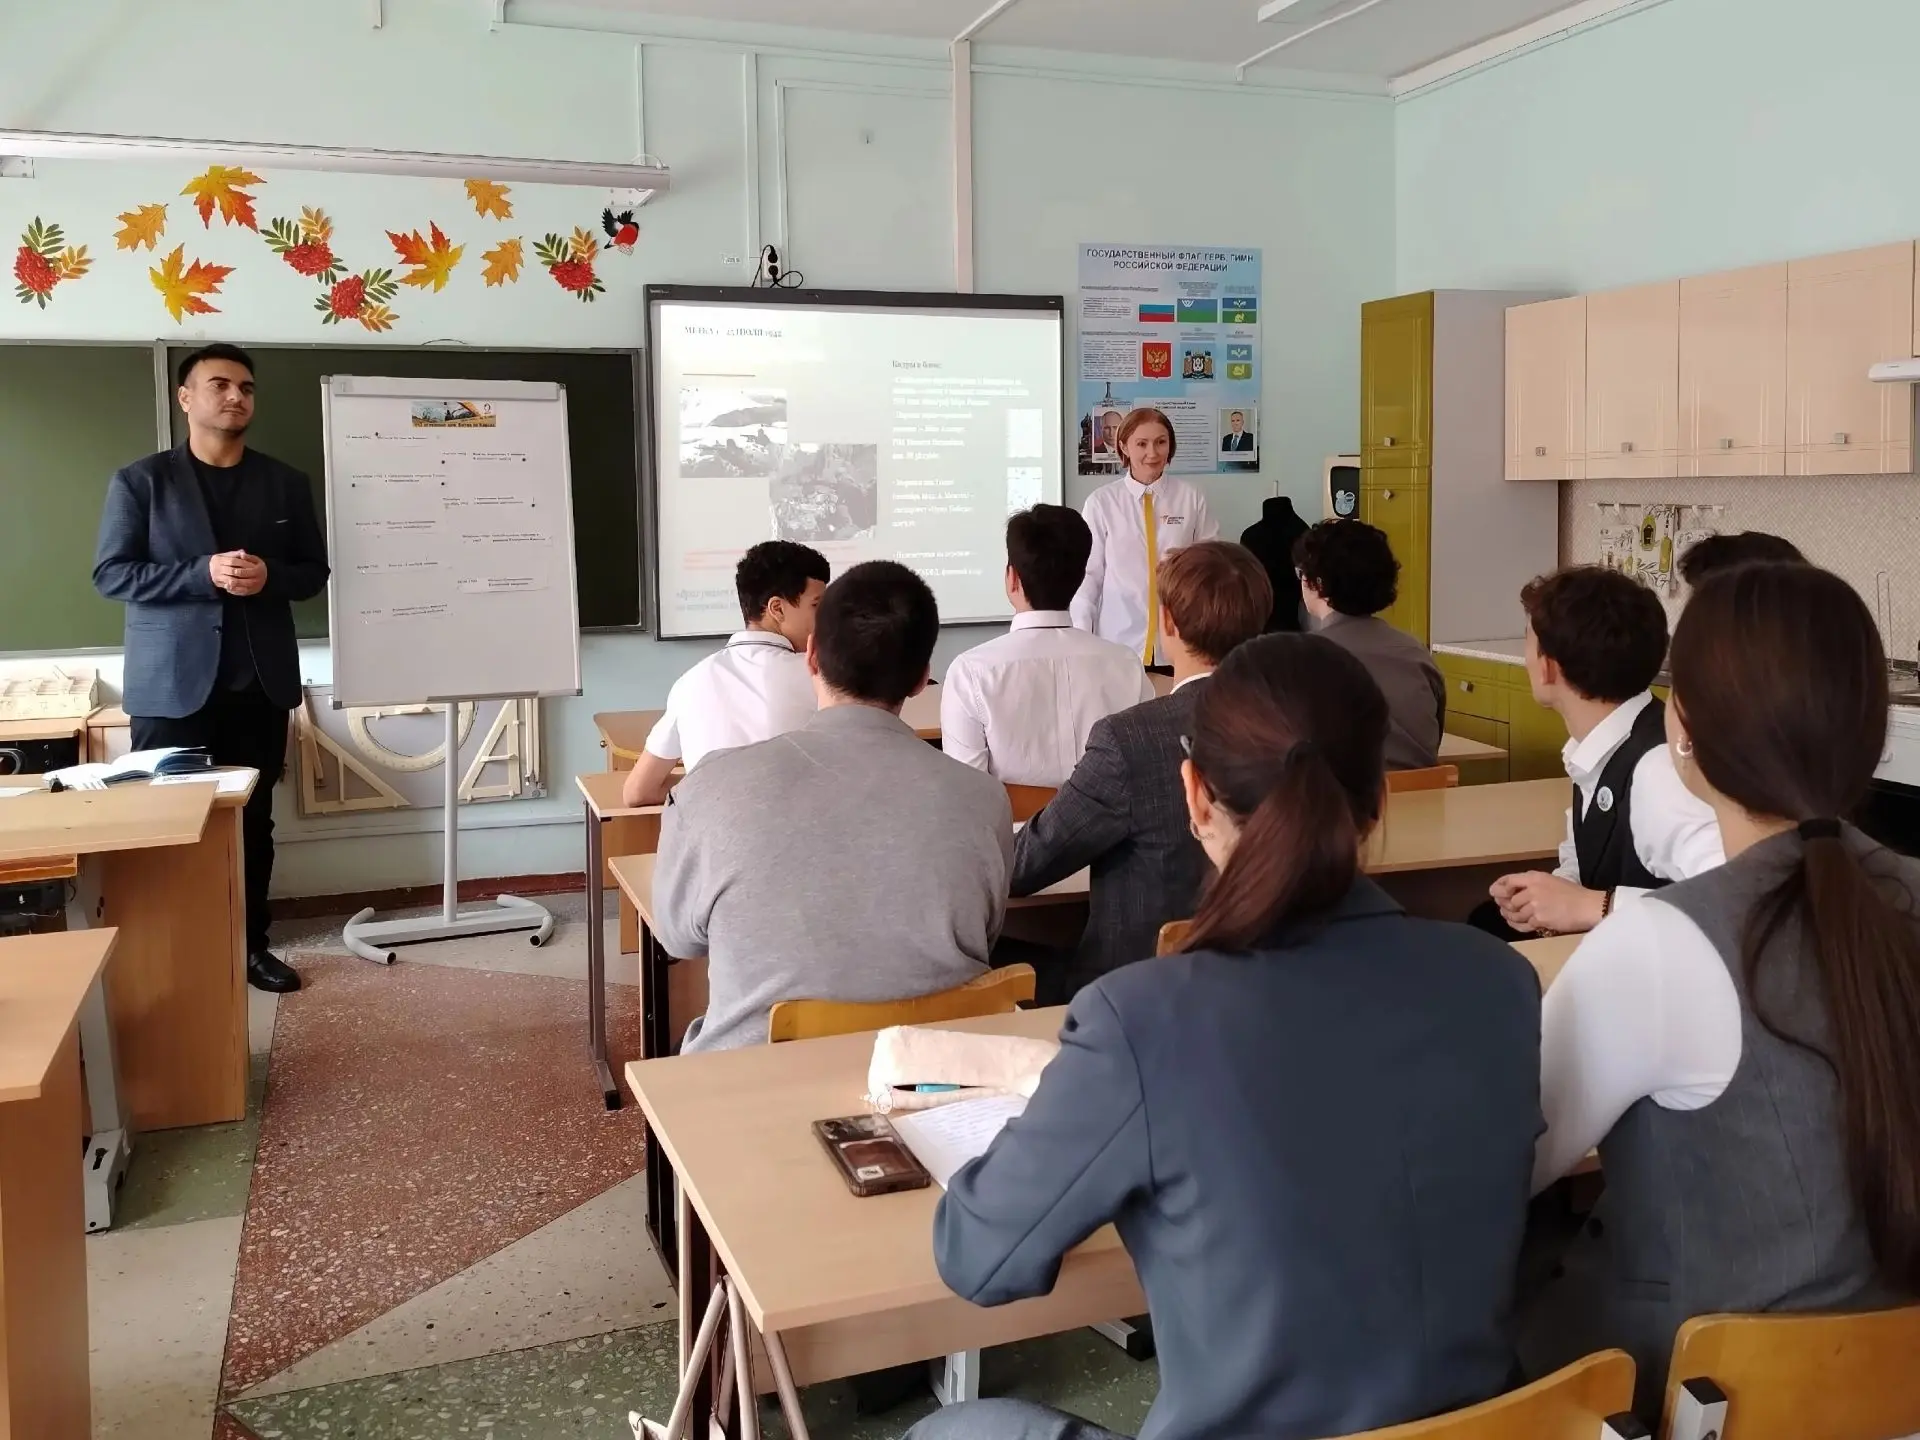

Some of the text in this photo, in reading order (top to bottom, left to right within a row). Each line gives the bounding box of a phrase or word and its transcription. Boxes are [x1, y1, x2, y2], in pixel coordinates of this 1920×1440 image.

[1086, 248, 1176, 260] ГОСУДАРСТВЕННЫЙ
[1113, 260, 1228, 273] РОССИЙСКОЙ ФЕДЕРАЦИИ
